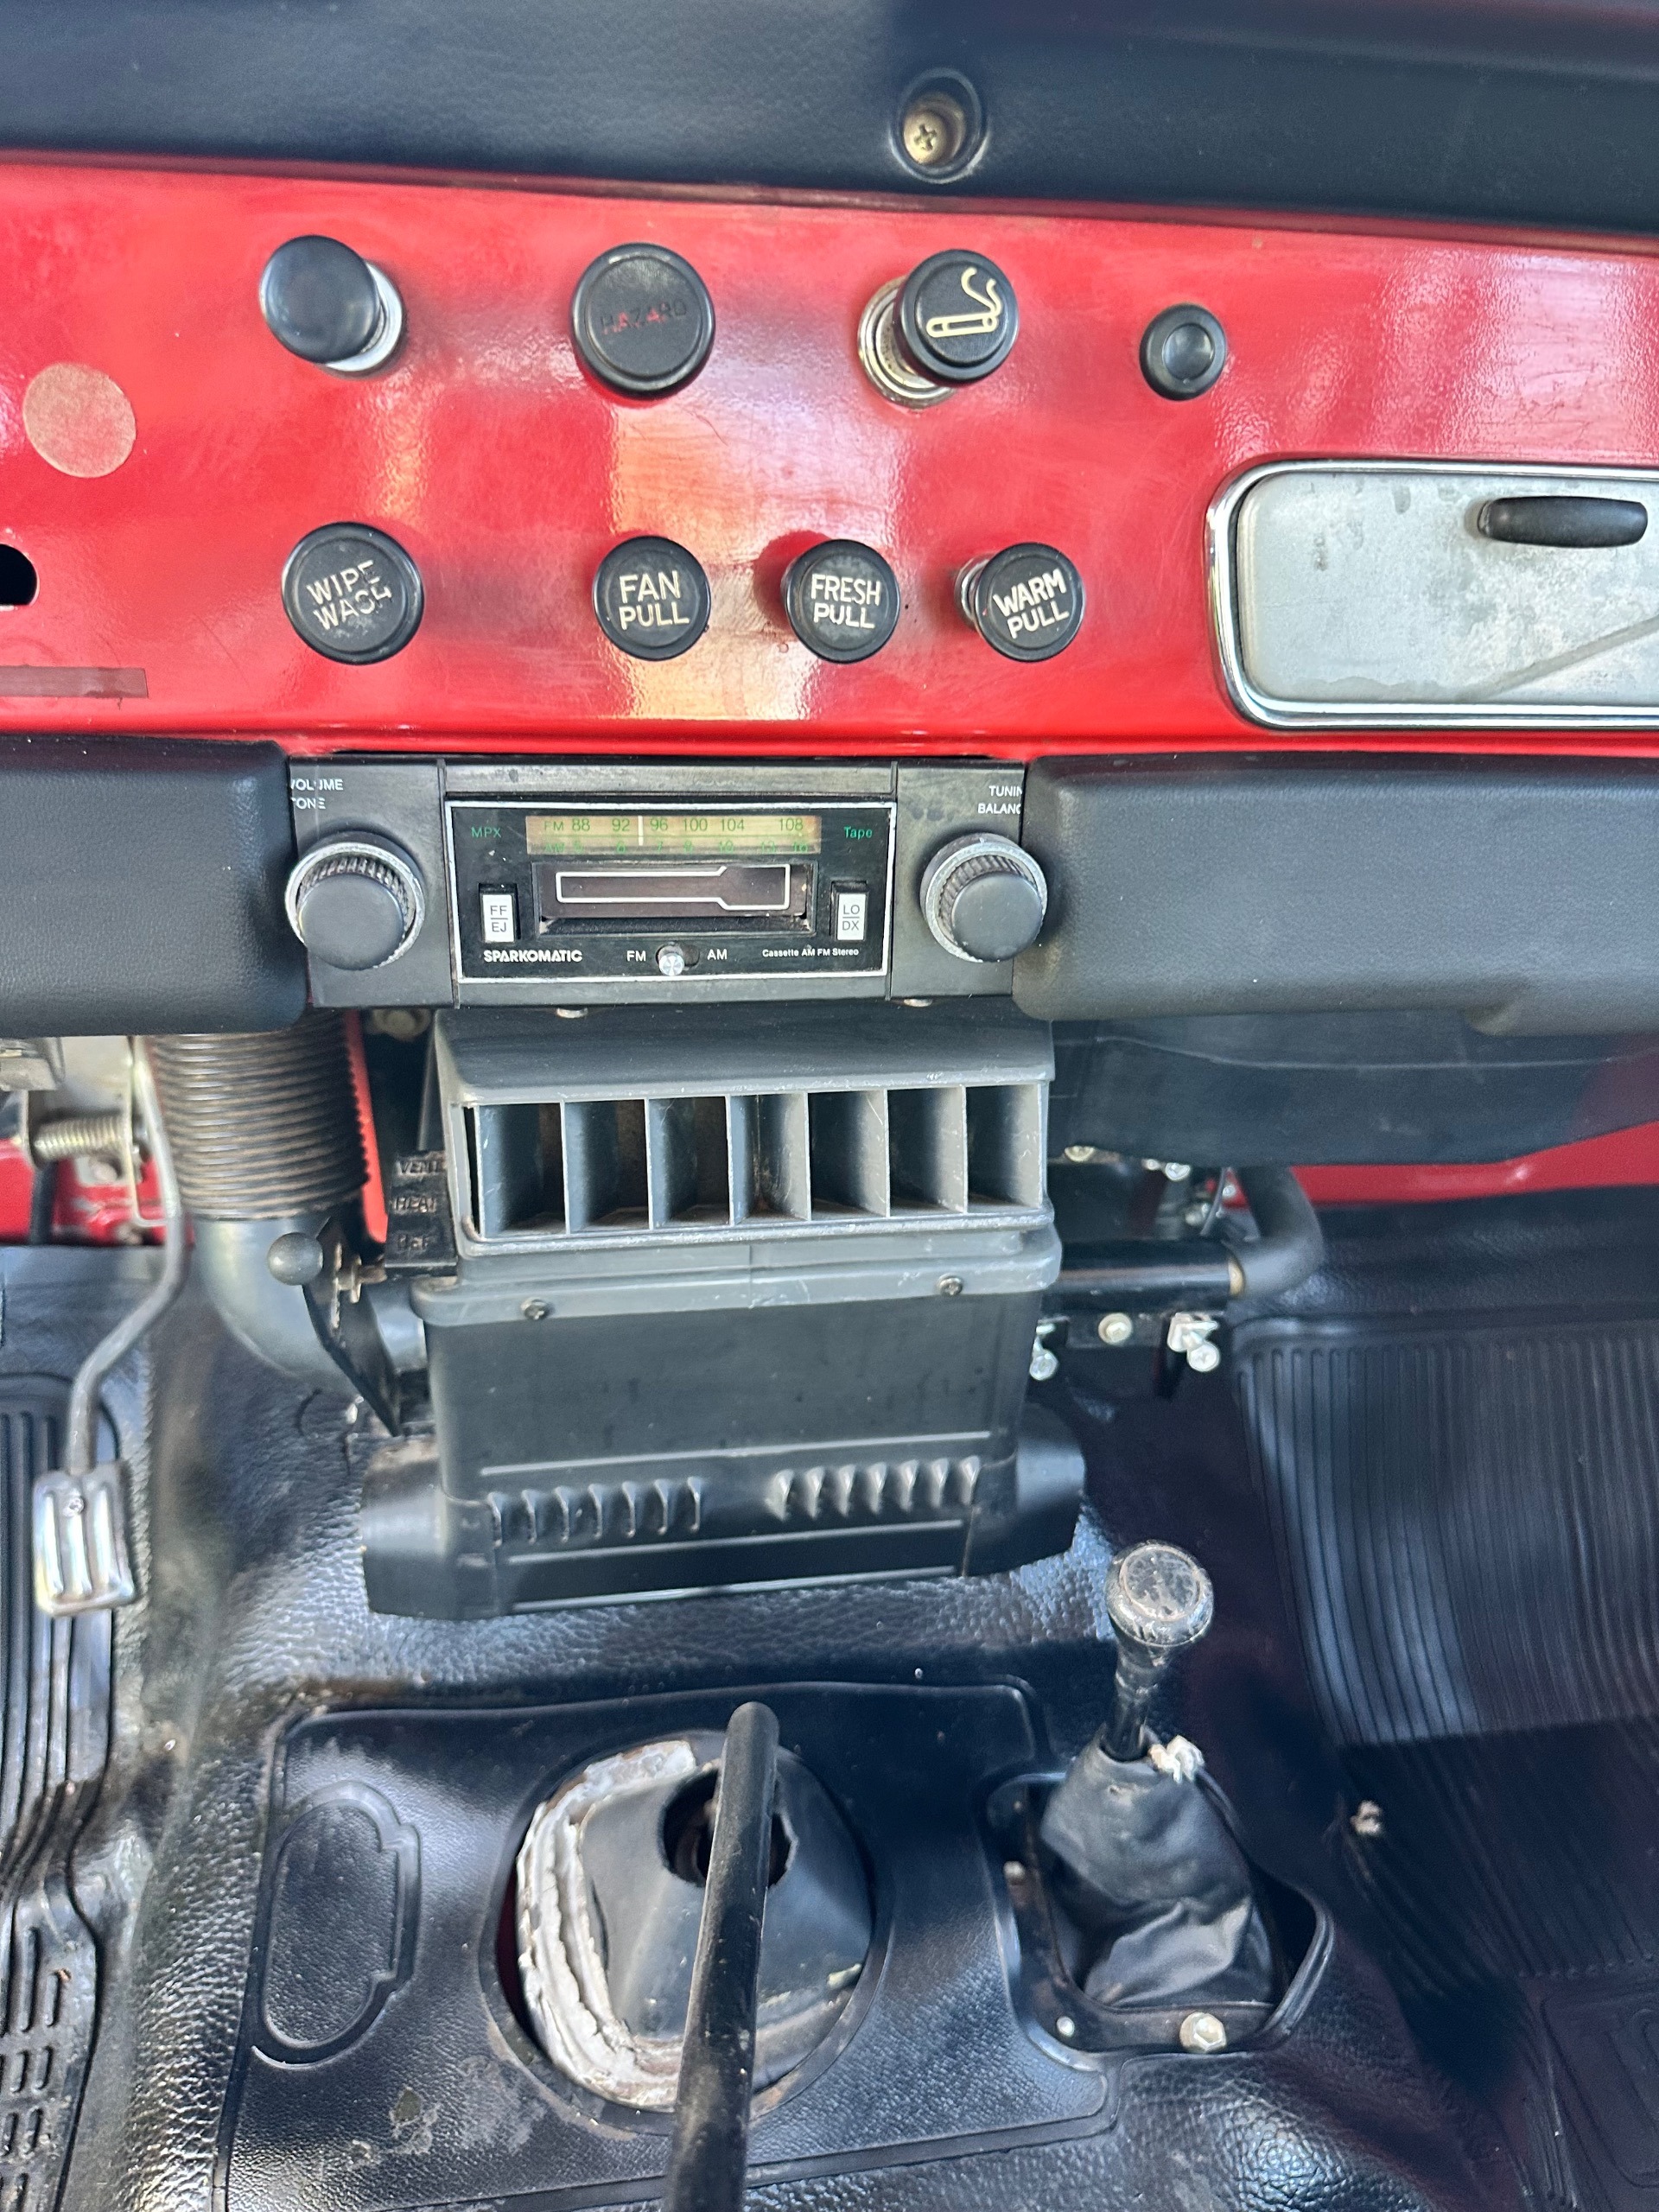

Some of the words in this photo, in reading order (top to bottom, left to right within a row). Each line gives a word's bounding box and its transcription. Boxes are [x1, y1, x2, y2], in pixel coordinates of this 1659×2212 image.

[306, 559, 380, 605] WIPE
[619, 569, 681, 604] FAN
[810, 573, 880, 607] FRESH
[992, 568, 1067, 617] WARM
[313, 586, 392, 631] WASH
[619, 601, 690, 630] PULL
[813, 602, 875, 629] PULL
[1007, 600, 1070, 639] PULL
[543, 821, 564, 831] FM
[572, 817, 590, 831] 88
[612, 817, 630, 831] 92
[650, 817, 668, 831] 96
[683, 817, 708, 831] 100
[720, 817, 745, 831] 104
[779, 817, 804, 831] 108
[471, 826, 501, 838] MPX
[843, 826, 873, 840] Tape
[490, 906, 508, 916] FF
[842, 904, 861, 915] LO
[491, 921, 507, 932] EJ
[842, 920, 860, 931] DX
[483, 950, 583, 963] SPARKOMATIC
[626, 950, 646, 962] FM
[707, 949, 728, 960] AM
[762, 949, 799, 957] Cassette
[801, 948, 816, 957] AM
[817, 948, 830, 957] FM
[832, 947, 860, 957] Stereo
